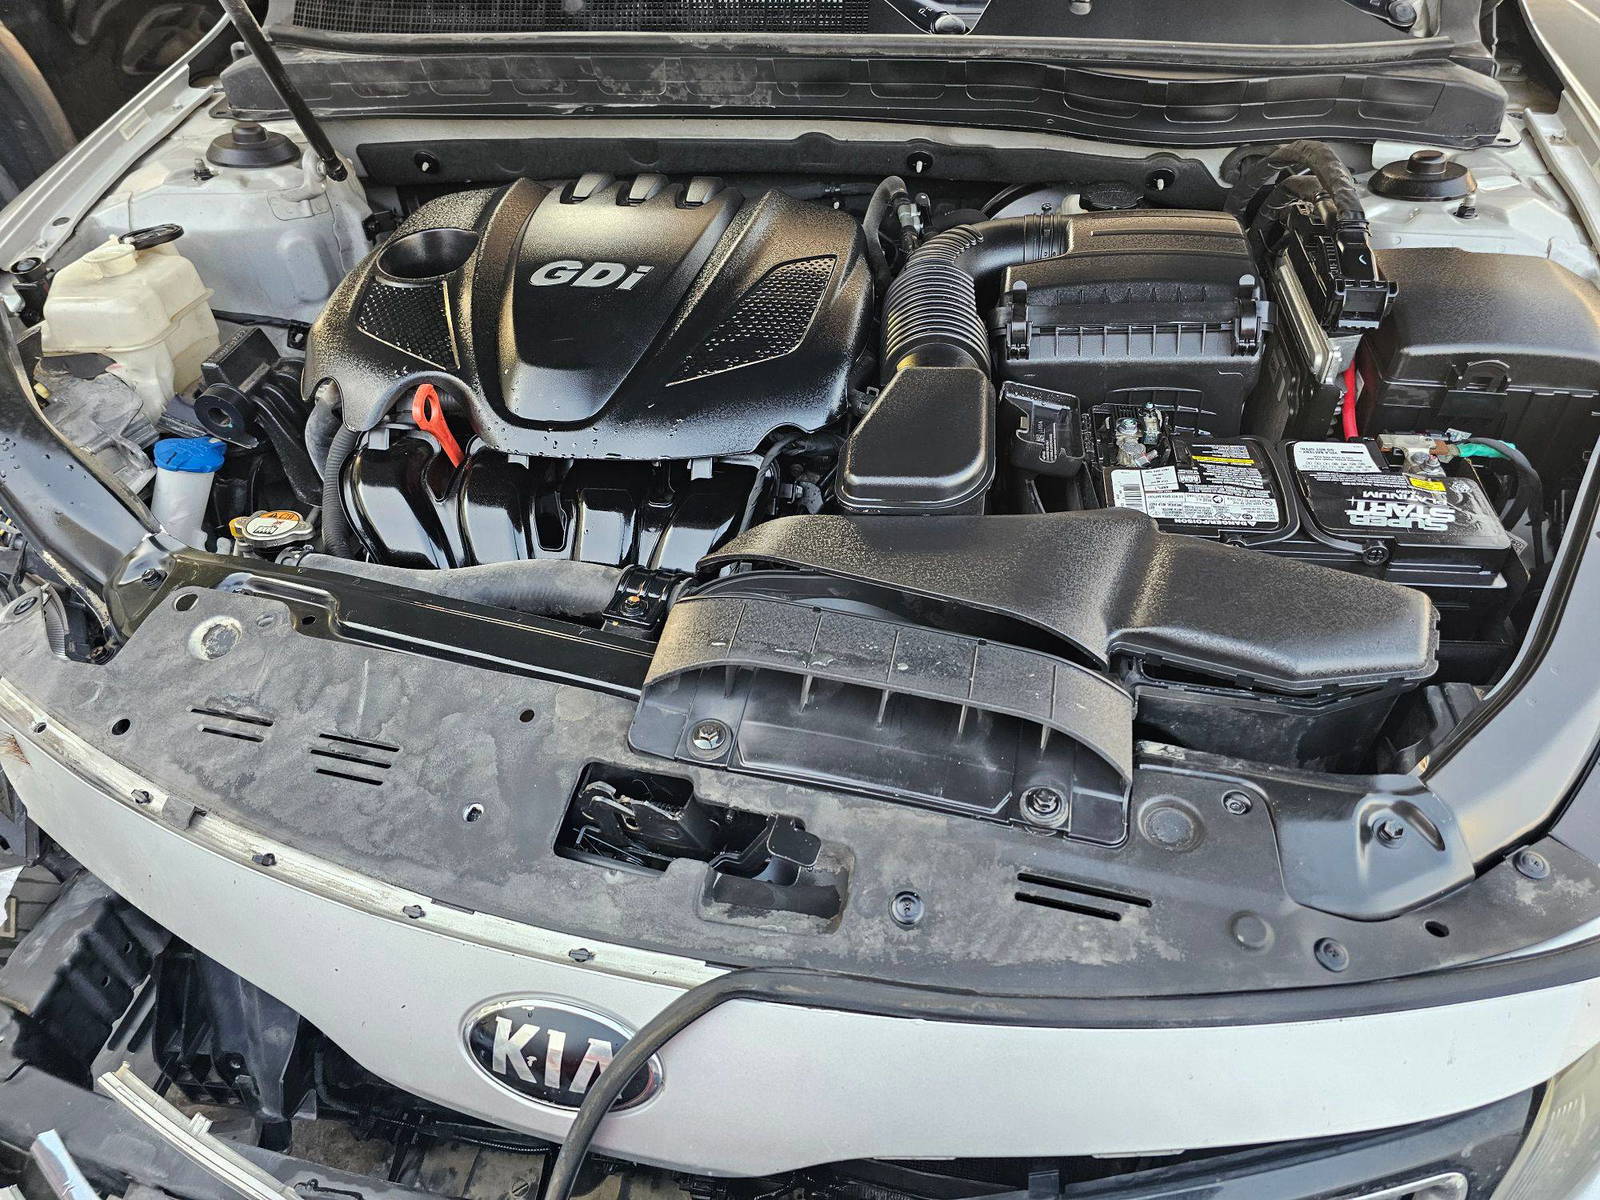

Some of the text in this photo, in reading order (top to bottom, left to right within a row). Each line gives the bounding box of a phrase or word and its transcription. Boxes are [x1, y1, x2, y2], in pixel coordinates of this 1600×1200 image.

[529, 260, 655, 290] GDi
[1362, 490, 1447, 505] PLATINUM
[1344, 500, 1456, 522] START
[1350, 514, 1449, 531] SUPER
[492, 1016, 615, 1094] KIA
